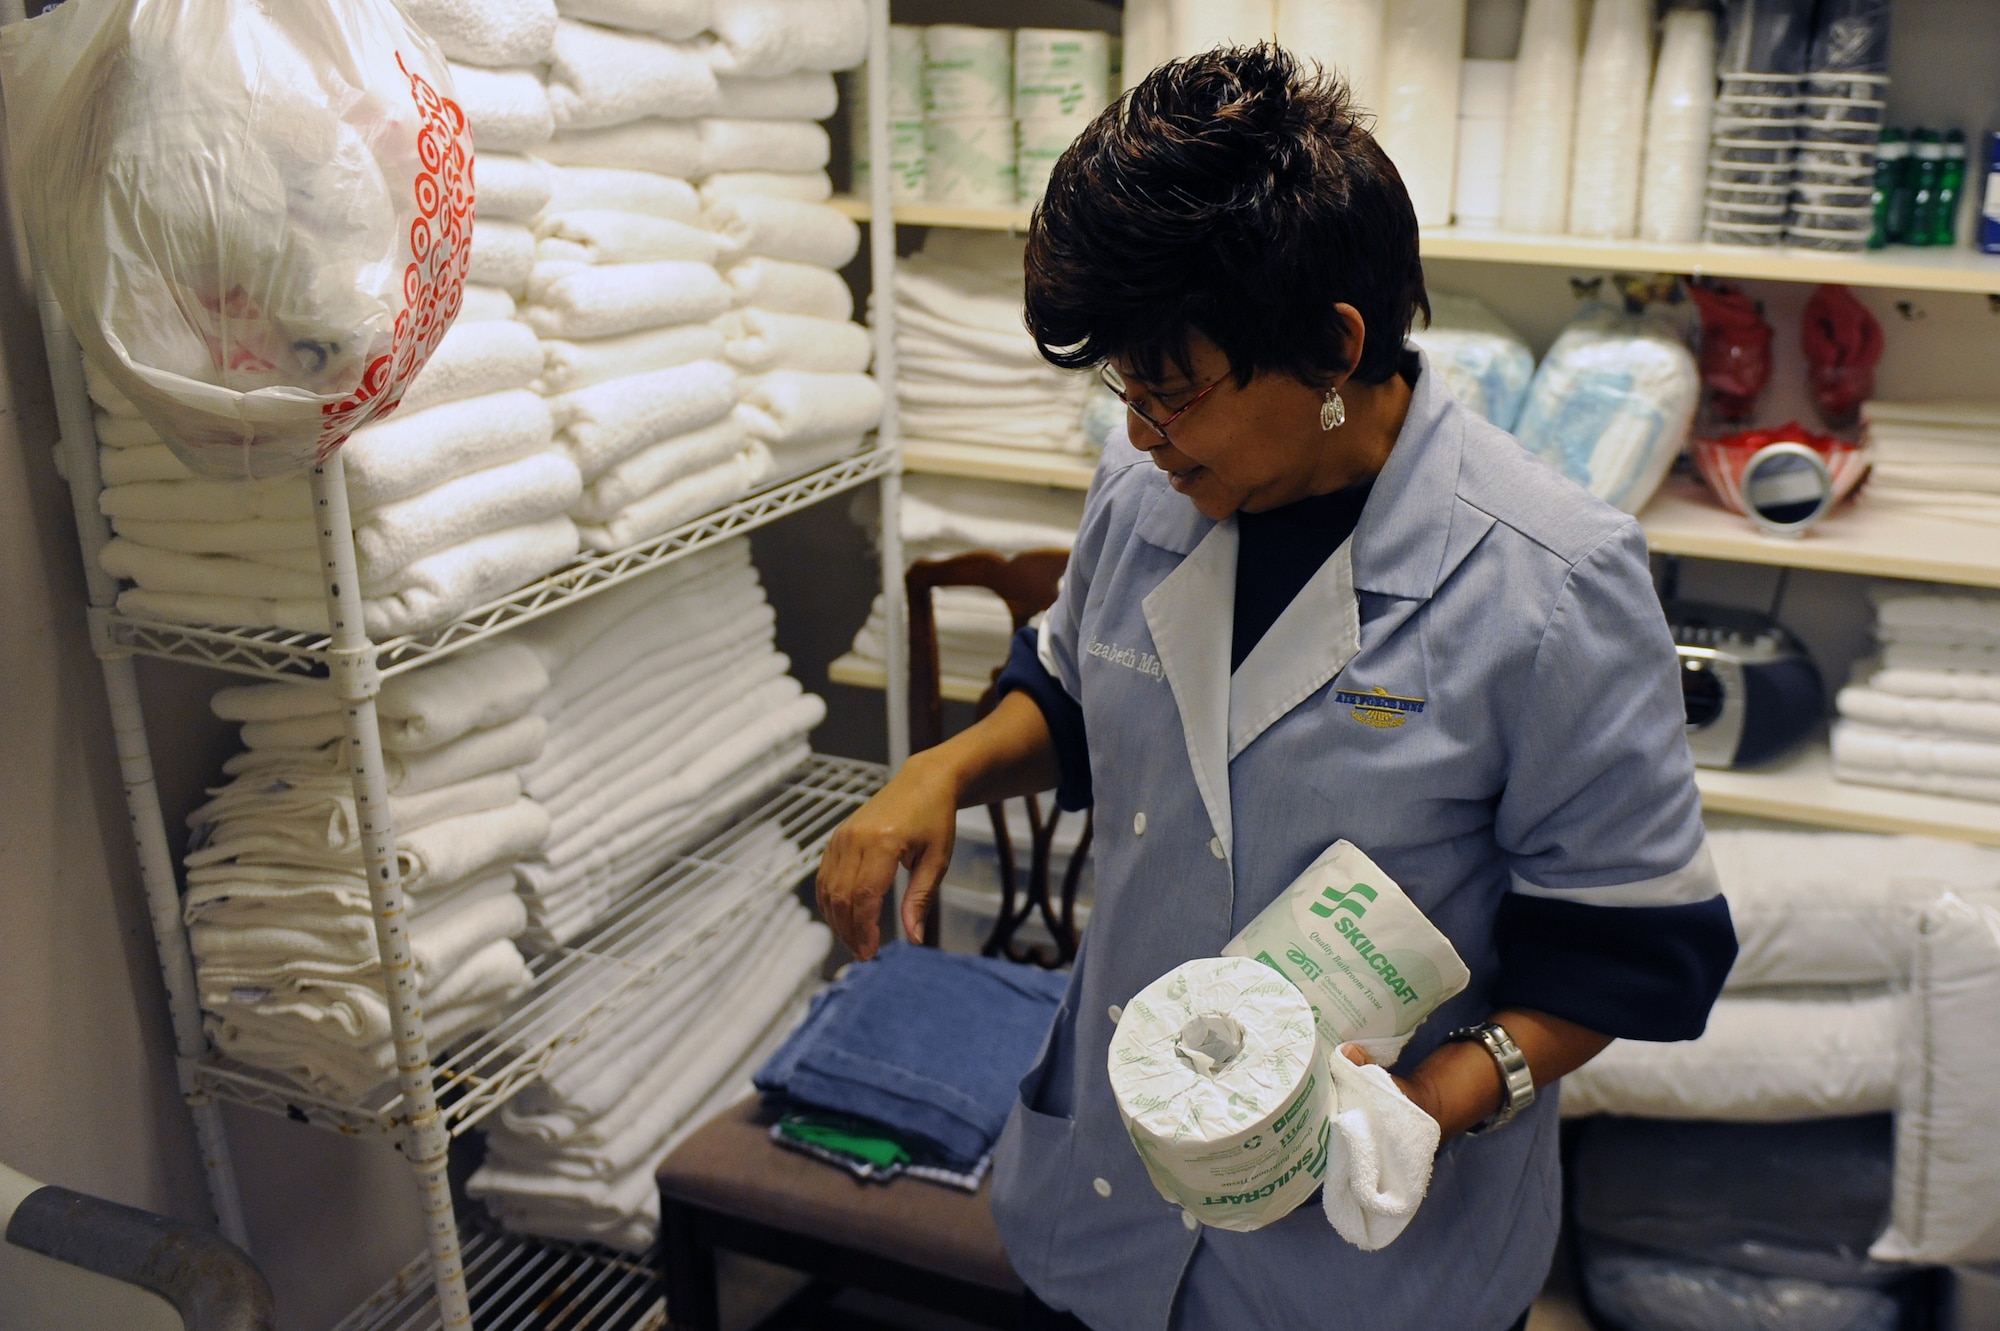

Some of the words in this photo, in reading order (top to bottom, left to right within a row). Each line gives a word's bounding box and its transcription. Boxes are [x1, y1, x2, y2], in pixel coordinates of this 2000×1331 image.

[1309, 931, 1334, 957] Quality
[1332, 954, 1365, 991] Bathroom
[1362, 988, 1383, 1011] Tissue
[1333, 916, 1419, 1006] SKILCRAFT
[1203, 1147, 1314, 1206] SKILCRAFT
